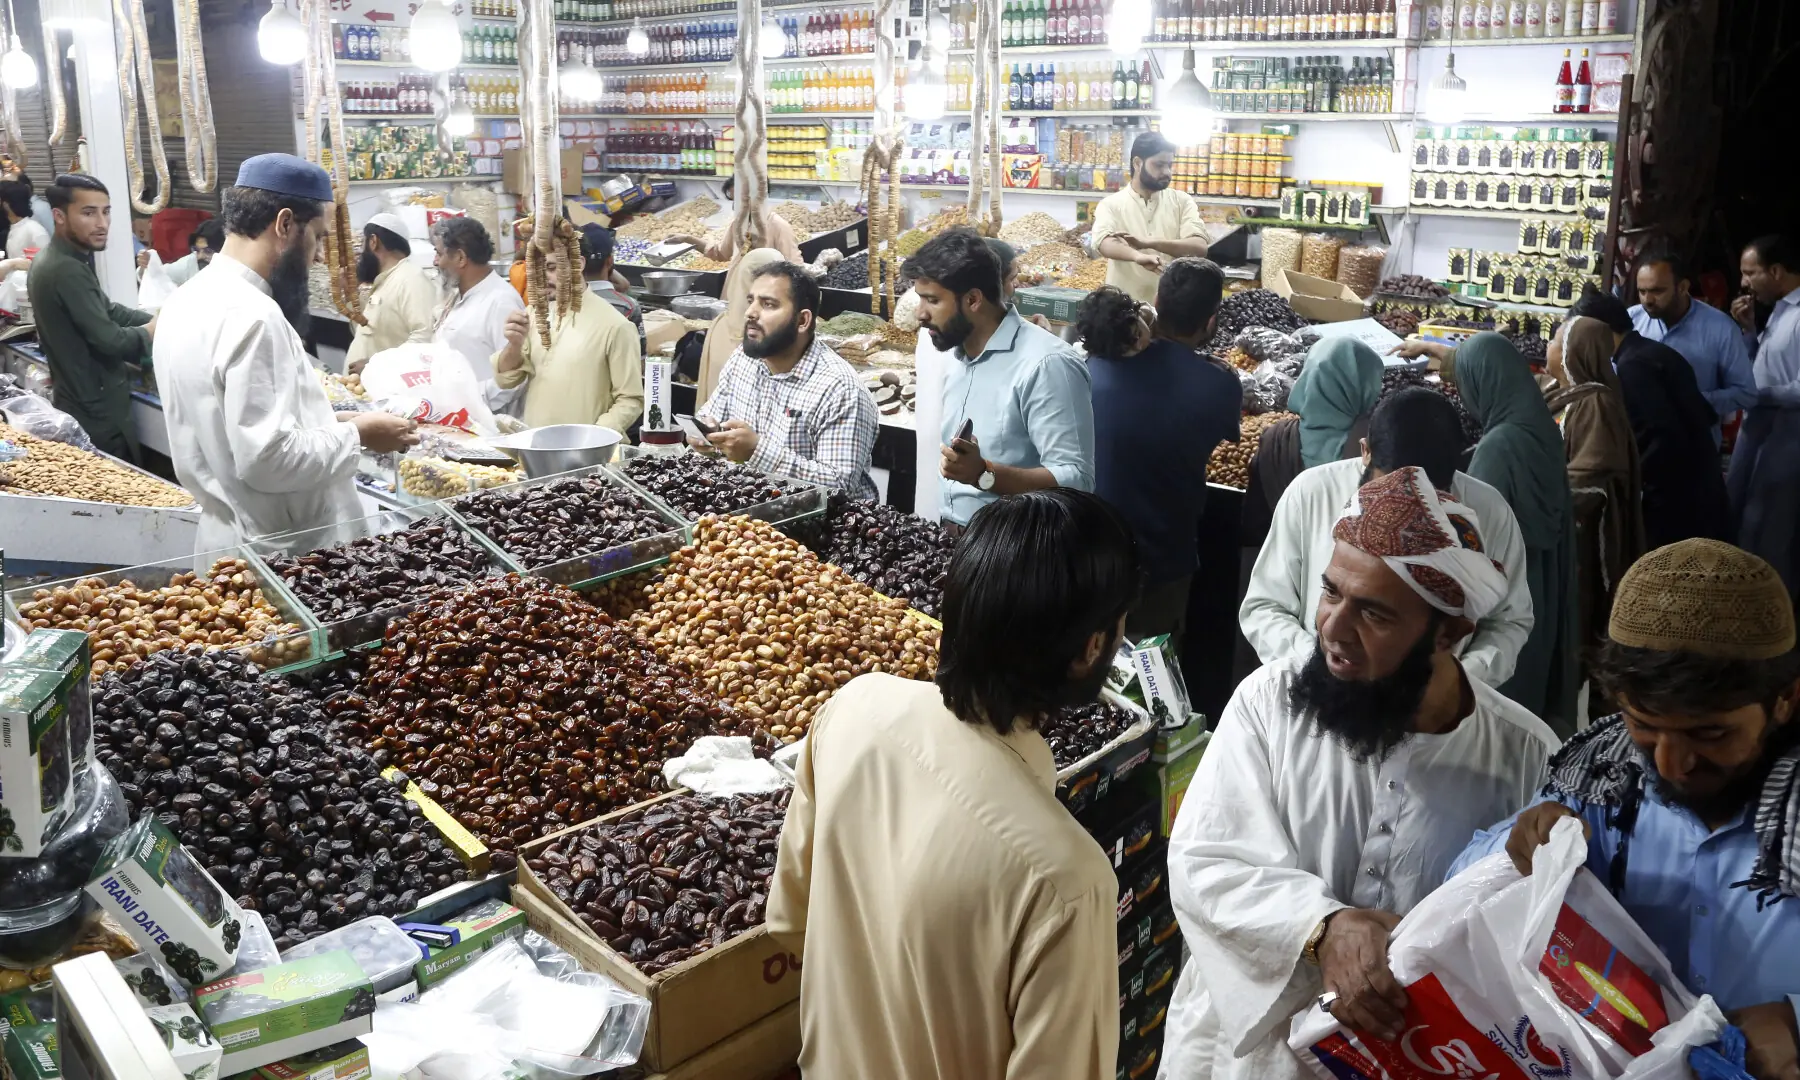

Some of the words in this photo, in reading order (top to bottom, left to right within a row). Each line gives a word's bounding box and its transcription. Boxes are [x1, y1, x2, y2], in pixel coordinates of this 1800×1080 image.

[652, 386, 660, 404] DATE
[1140, 652, 1153, 674] IRANI
[1146, 675, 1160, 697] DATE
[33, 694, 57, 724] FAMOUS
[3, 717, 12, 749] FAMOUS
[139, 831, 158, 862] FAMOUS
[116, 870, 142, 896] FAMOUS
[100, 876, 139, 913] IRANI
[132, 910, 170, 945] DATE
[425, 954, 461, 976] Maryam
[204, 979, 238, 992] Dates
[30, 1042, 59, 1072] FAMOUS
